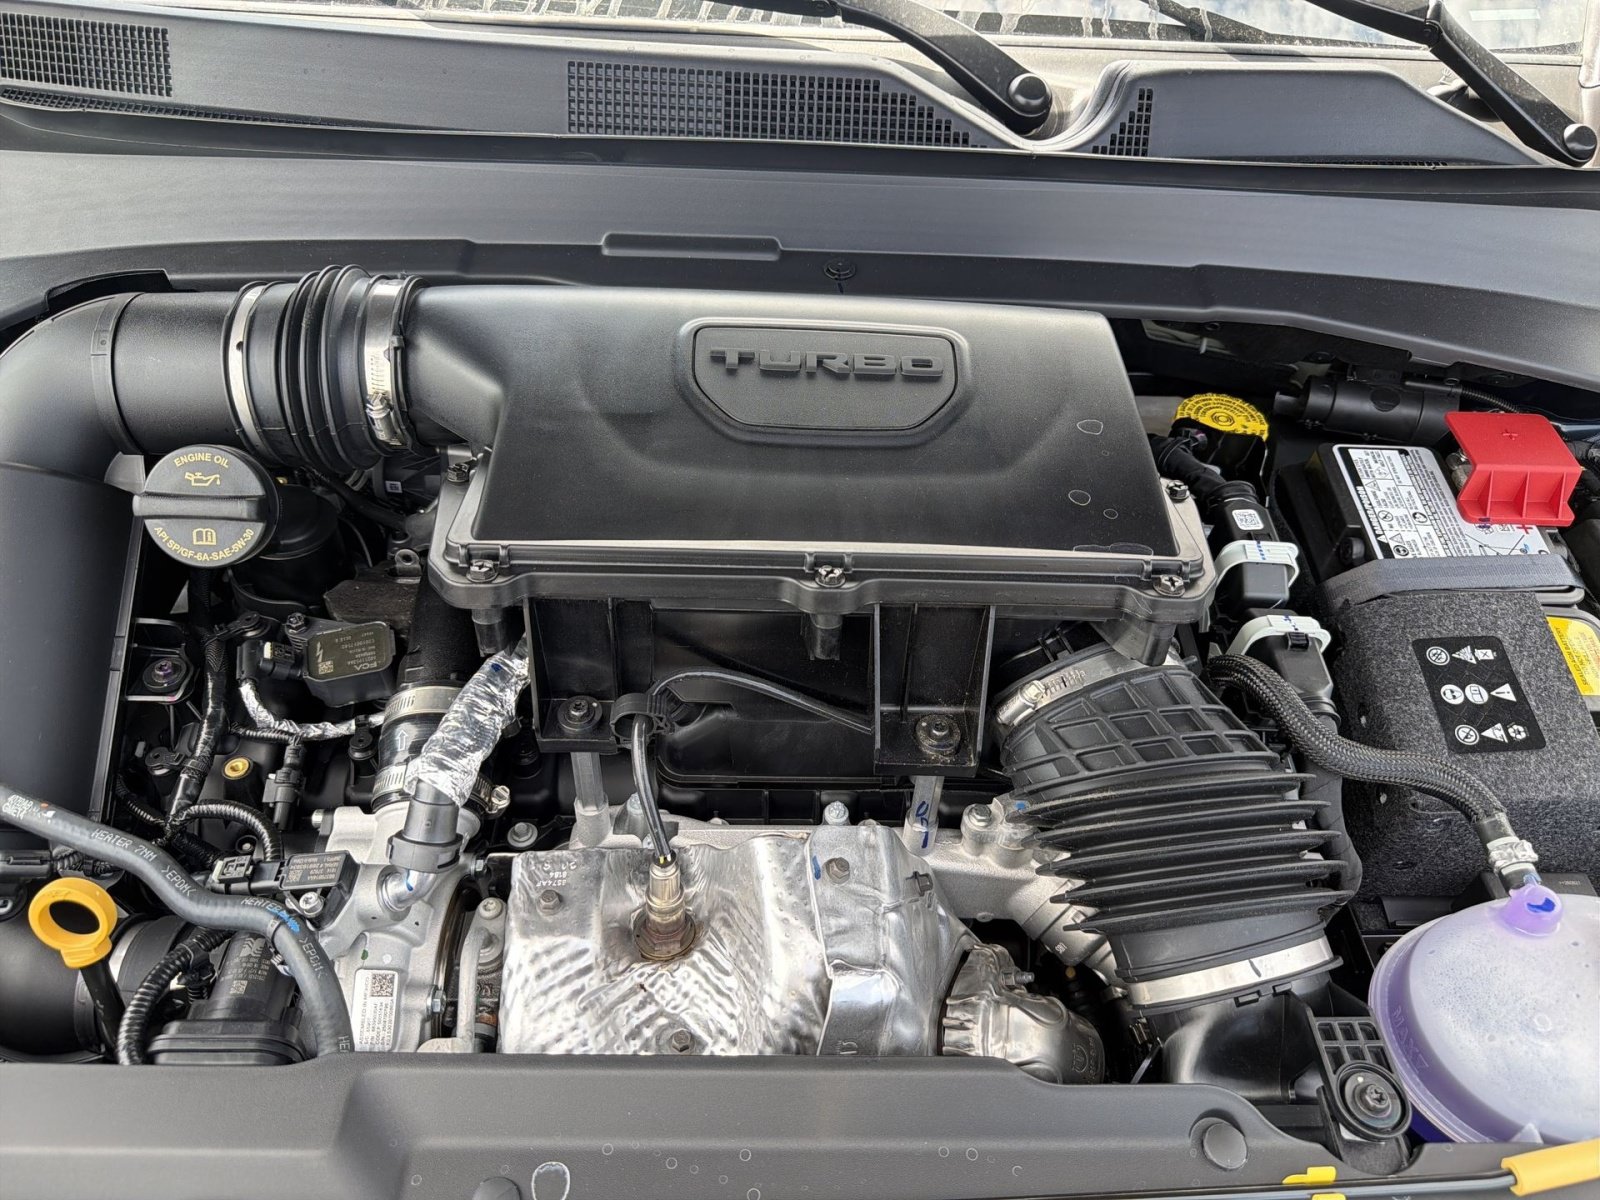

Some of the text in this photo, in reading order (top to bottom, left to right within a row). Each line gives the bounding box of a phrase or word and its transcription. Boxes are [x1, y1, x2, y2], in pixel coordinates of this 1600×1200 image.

[710, 347, 943, 377] TURBO
[173, 452, 230, 468] ENGINE OIL
[153, 526, 255, 561] API SP/GF-6A-SAE-5W-30
[353, 660, 378, 672] FCA
[90, 828, 133, 849] HEATER
[134, 844, 158, 862] 7MM
